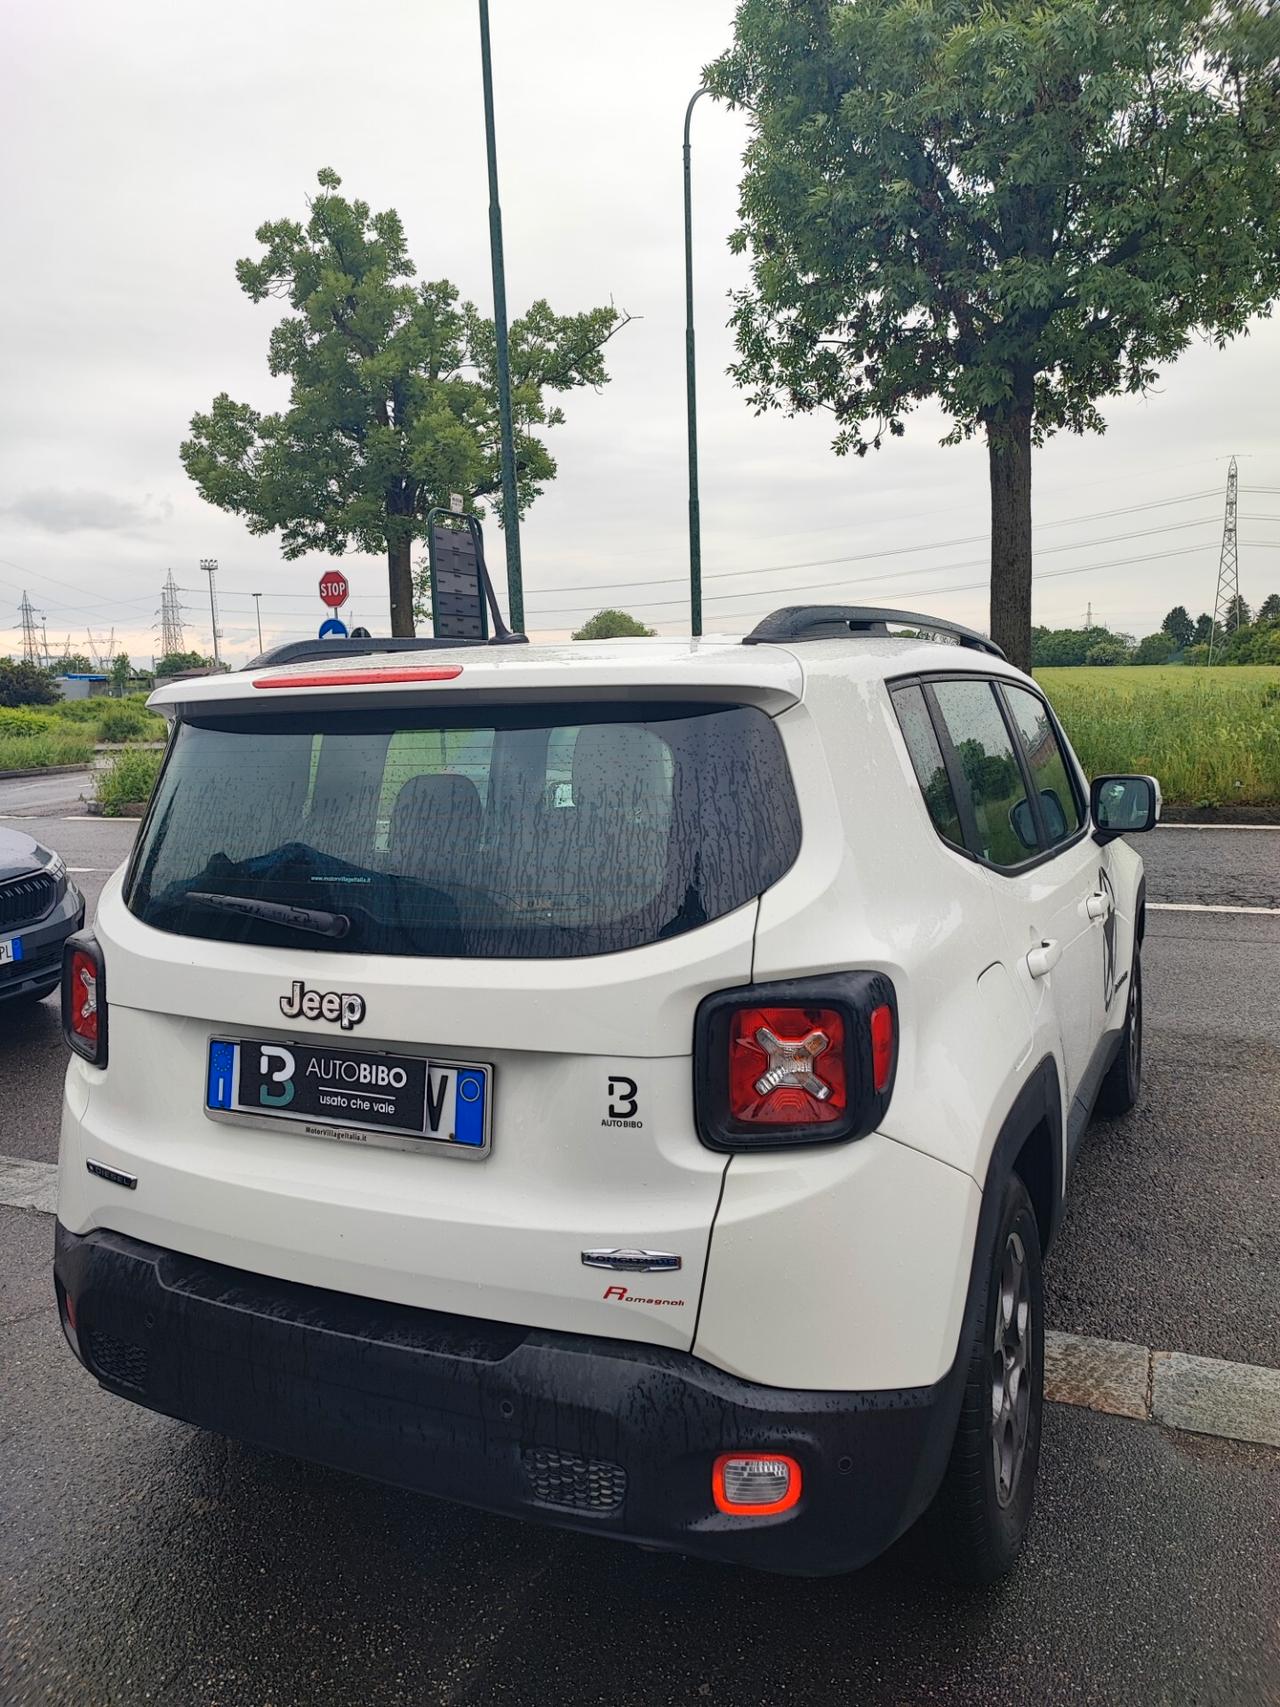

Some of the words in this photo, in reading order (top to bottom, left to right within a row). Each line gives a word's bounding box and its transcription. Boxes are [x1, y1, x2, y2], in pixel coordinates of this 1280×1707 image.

[320, 582, 346, 597] STOP
[280, 980, 366, 1030] Jeep
[305, 1057, 408, 1089] AUTOBIBO
[319, 1095, 348, 1108] usato
[350, 1098, 371, 1111] che
[373, 1101, 396, 1114] vale
[426, 1074, 449, 1132] V
[601, 1119, 643, 1128] AUTOBIBO
[603, 1286, 685, 1306] Romagnoli
